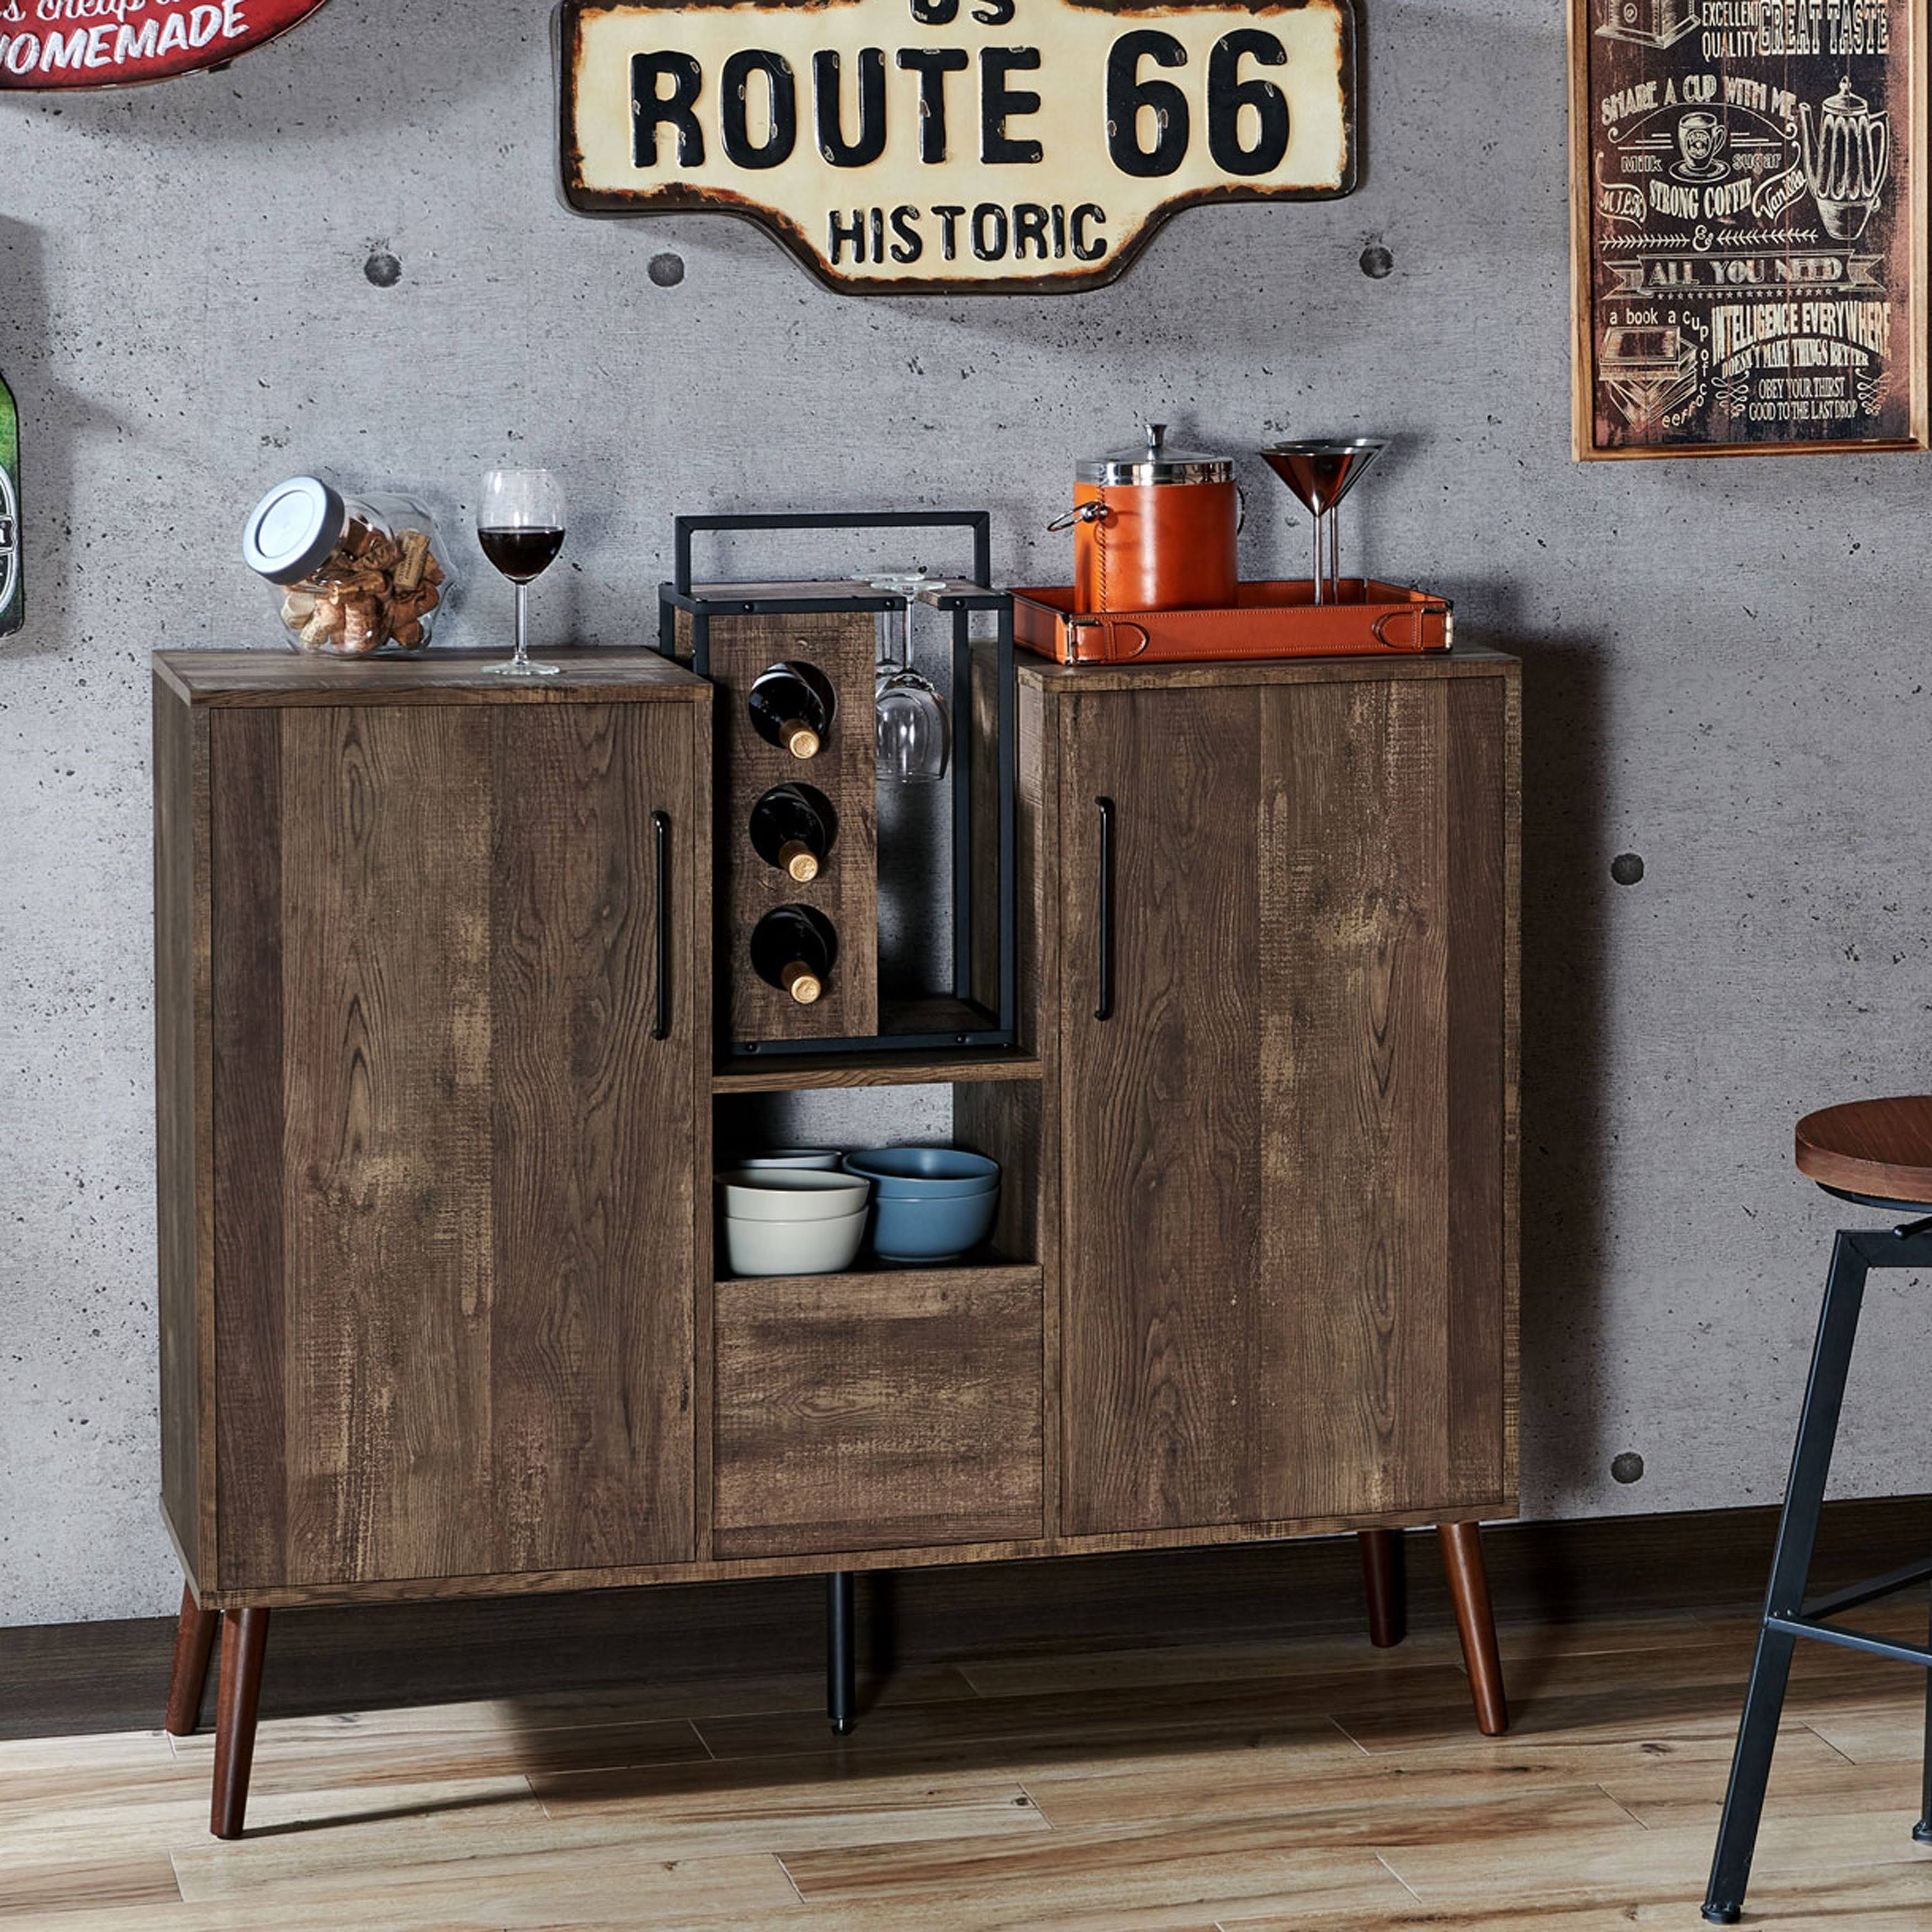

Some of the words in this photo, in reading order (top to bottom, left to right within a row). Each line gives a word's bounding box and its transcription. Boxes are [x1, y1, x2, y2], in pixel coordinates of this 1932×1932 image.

[1702, 1, 1758, 26] EXCELLENT
[1759, 0, 1822, 56] GREAT
[1827, 0, 1889, 55] TASTE
[1702, 31, 1758, 62] QUALITY
[629, 46, 1043, 170] ROUTE
[1106, 28, 1290, 177] 66
[1601, 81, 1658, 125] SHARE
[1664, 77, 1678, 105] A
[1682, 74, 1717, 103] CUP
[1723, 75, 1767, 112] WITH
[1771, 86, 1797, 121] ME
[1649, 178, 1699, 220] STRONG
[1703, 178, 1751, 219] COFFEE
[1760, 169, 1807, 219] Vanilla
[828, 203, 1108, 264] HISTORIC
[1692, 224, 1713, 252] &
[1648, 261, 1700, 285] ALL
[1710, 259, 1765, 284] YOU
[1774, 256, 1843, 283] NEED
[1609, 311, 1618, 325] a
[1626, 307, 1659, 325] book
[1668, 310, 1676, 325] a
[1682, 310, 1709, 342] cup
[1700, 349, 1710, 377] of
[1712, 303, 1798, 367] INTELLIGENCE
[1802, 301, 1892, 362] EVERYWHERE
[1763, 340, 1790, 369] MAKE
[1792, 338, 1828, 367] THINGS
[1829, 339, 1870, 367] BETTER
[1759, 378, 1784, 399] OBEY
[1786, 378, 1813, 399] YOUR
[1813, 376, 1845, 397] THIRST
[1749, 402, 1776, 421] GOOD
[1776, 401, 1790, 421] TO
[1790, 400, 1811, 420] THE
[1811, 400, 1834, 420] LAST
[1834, 399, 1858, 418] DROP
